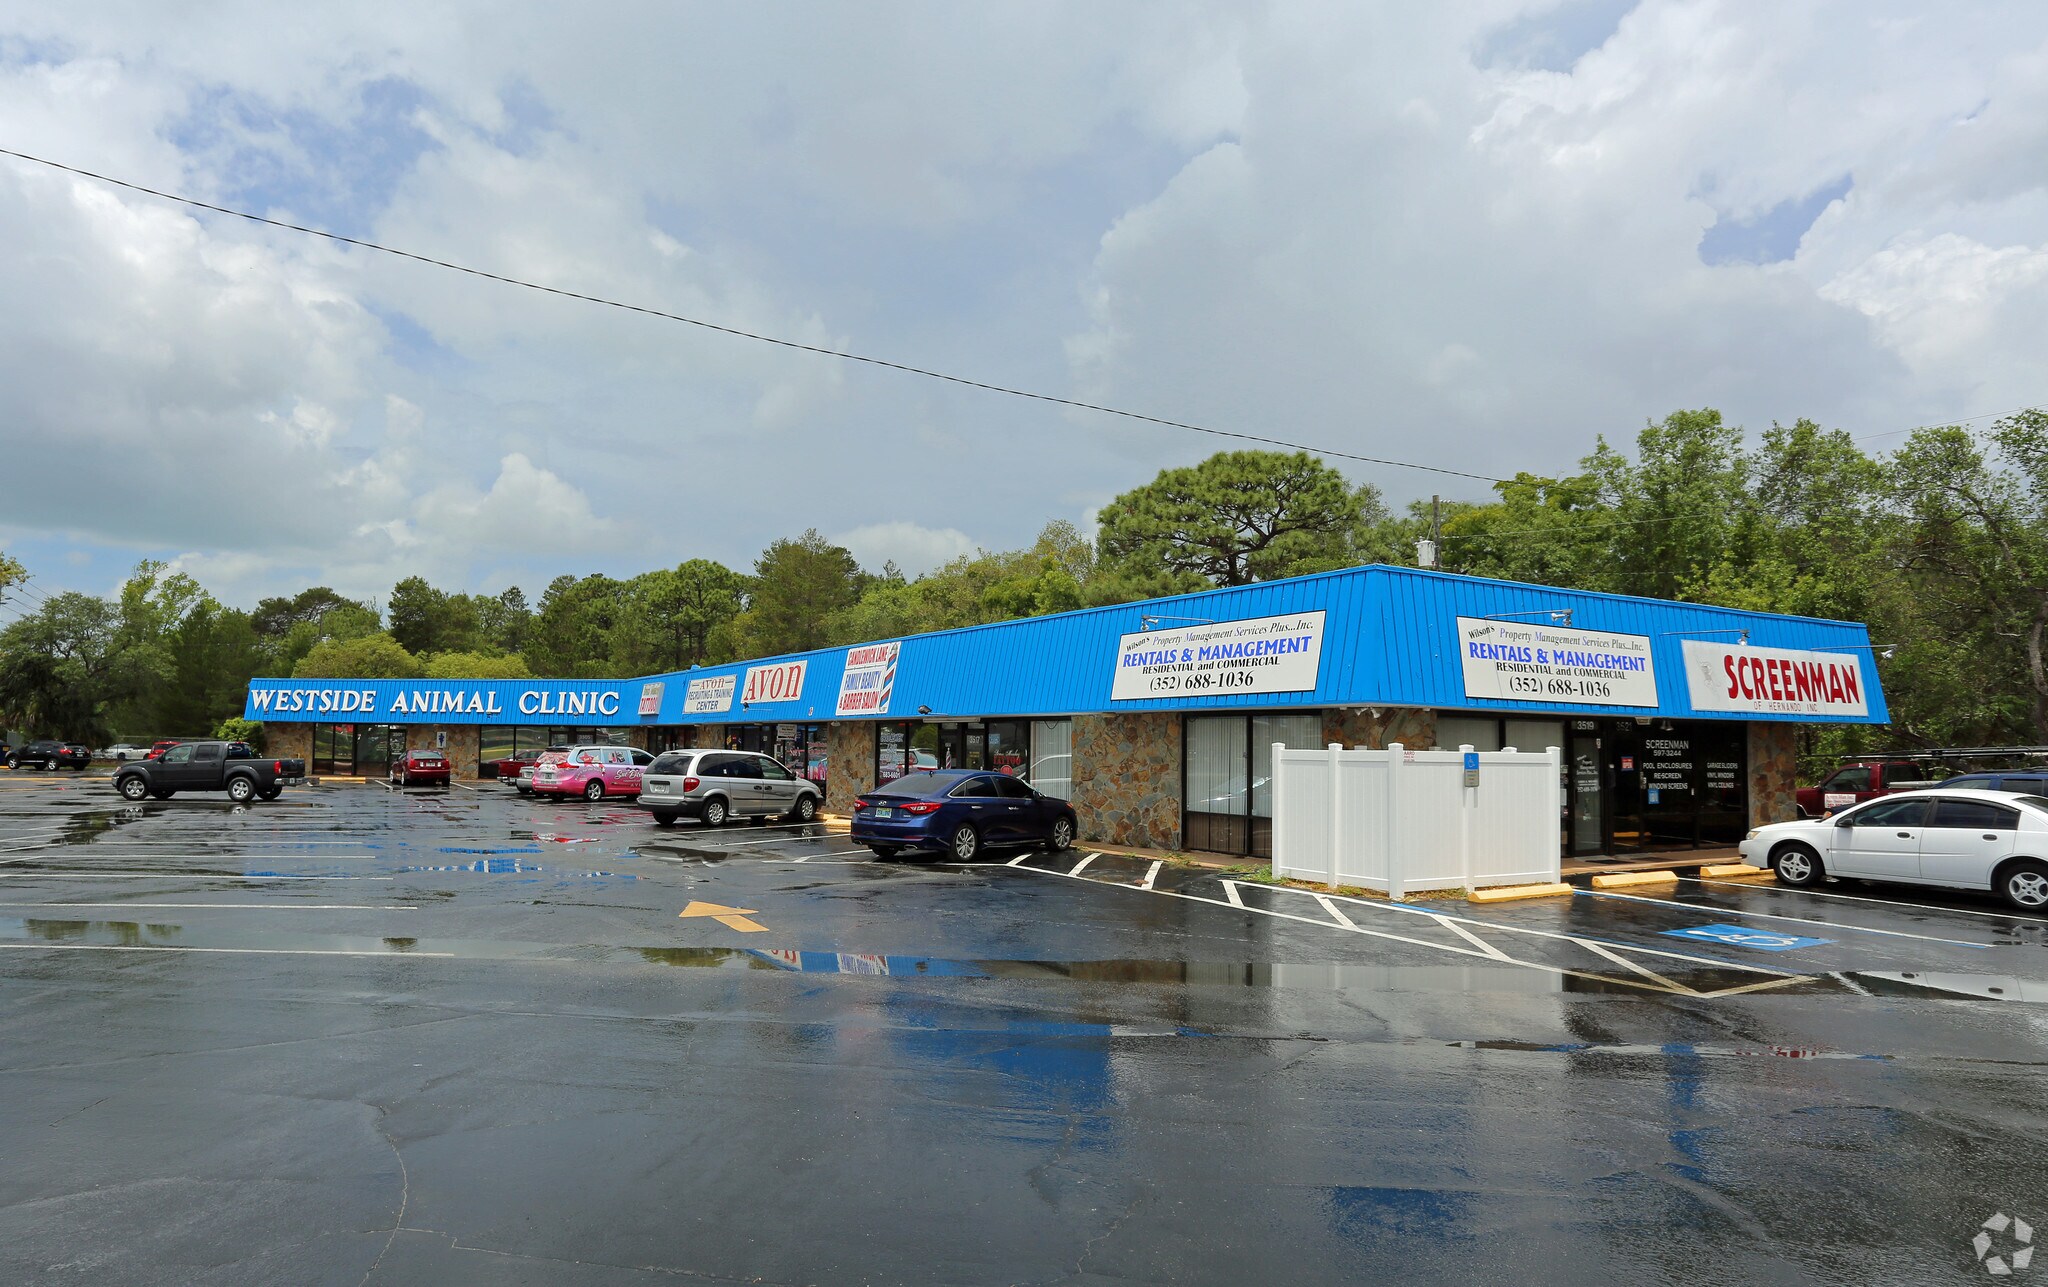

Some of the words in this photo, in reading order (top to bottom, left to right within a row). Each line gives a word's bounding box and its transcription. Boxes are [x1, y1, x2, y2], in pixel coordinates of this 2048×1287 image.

[1126, 636, 1150, 652] Wilson's
[1152, 636, 1182, 647] Property
[1185, 630, 1233, 642] Management
[1235, 625, 1268, 637] Services
[1468, 625, 1495, 639] Wilson's
[1500, 627, 1532, 643] Property
[1534, 631, 1580, 646] Management
[1582, 636, 1609, 648] Services
[876, 646, 889, 662] LANE
[1122, 649, 1178, 667] RENTALS
[1180, 648, 1194, 662] &
[1198, 636, 1312, 661] MANAGEMENT
[1469, 642, 1532, 663] RENTALS
[1537, 648, 1549, 664] &
[1553, 650, 1646, 671] MANAGEMENT
[1142, 663, 1195, 674] RESIDENTIAL
[1197, 661, 1214, 671] and
[1217, 656, 1280, 668] COMMERCIAL
[1496, 662, 1553, 674] RESIDENTIAL
[1556, 667, 1571, 676] and
[1574, 667, 1627, 680] COMMERCIAL
[844, 673, 862, 690] FAMILY
[861, 671, 882, 689] BEAUTY
[1150, 675, 1181, 692] (352)
[1185, 670, 1255, 689] 688-1036
[1510, 675, 1543, 695] (352)
[1548, 679, 1611, 697] 688-1036
[1724, 655, 1860, 704] SCREENMAN
[251, 689, 376, 712] WESTSIDE
[389, 691, 502, 713] ANIMAL
[519, 692, 619, 715] CLINIC
[696, 701, 719, 710] CENTER
[843, 692, 862, 710] BARBER
[861, 691, 879, 709] SALON
[1769, 702, 1801, 712] HERNANDO
[1807, 704, 1820, 712] INC.
[1577, 721, 1594, 730] 3519
[1645, 740, 1689, 749] SCREENMAN
